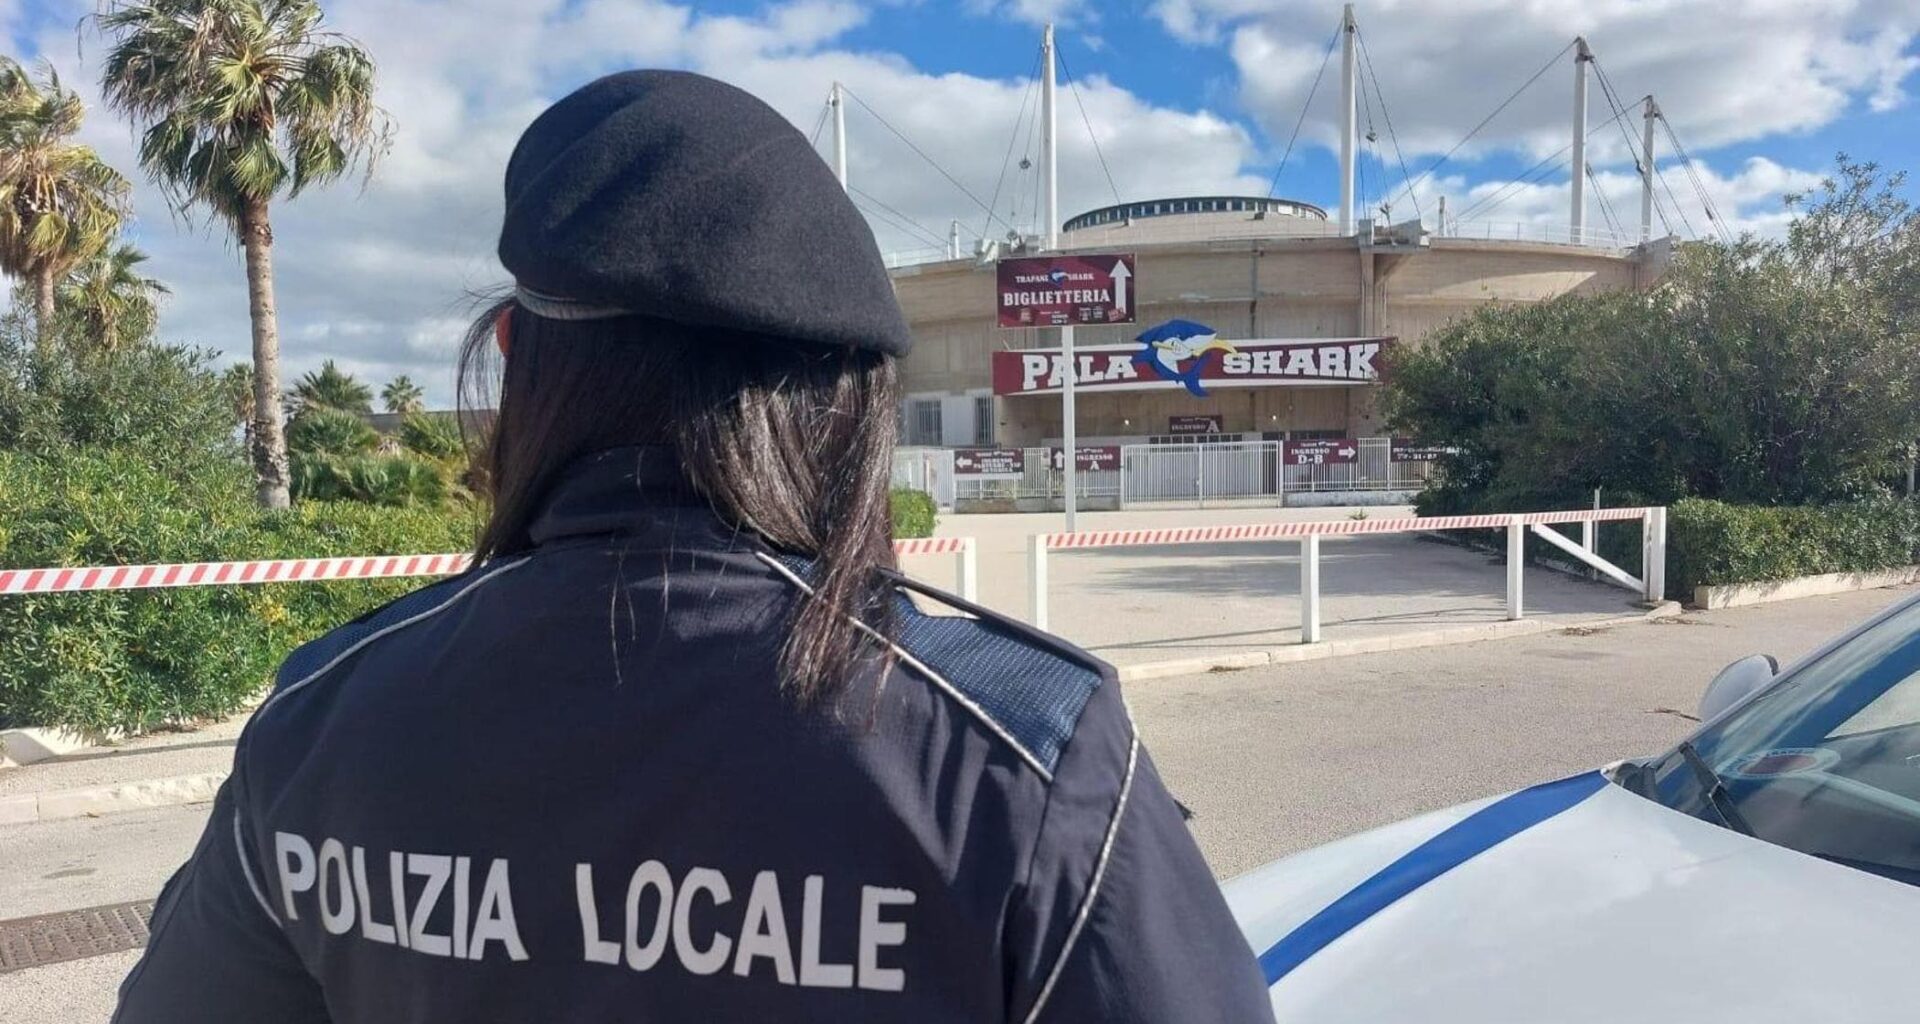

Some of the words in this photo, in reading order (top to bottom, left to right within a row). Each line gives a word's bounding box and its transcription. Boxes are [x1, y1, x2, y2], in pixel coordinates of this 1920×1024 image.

[1003, 289, 1111, 306] BIGLIETTERIA
[1022, 355, 1138, 390] PALA
[1222, 343, 1380, 379] SHARK
[1206, 420, 1220, 433] A
[1090, 460, 1100, 470] A
[274, 831, 530, 962] POLIZIA
[575, 859, 917, 992] LOCALE
